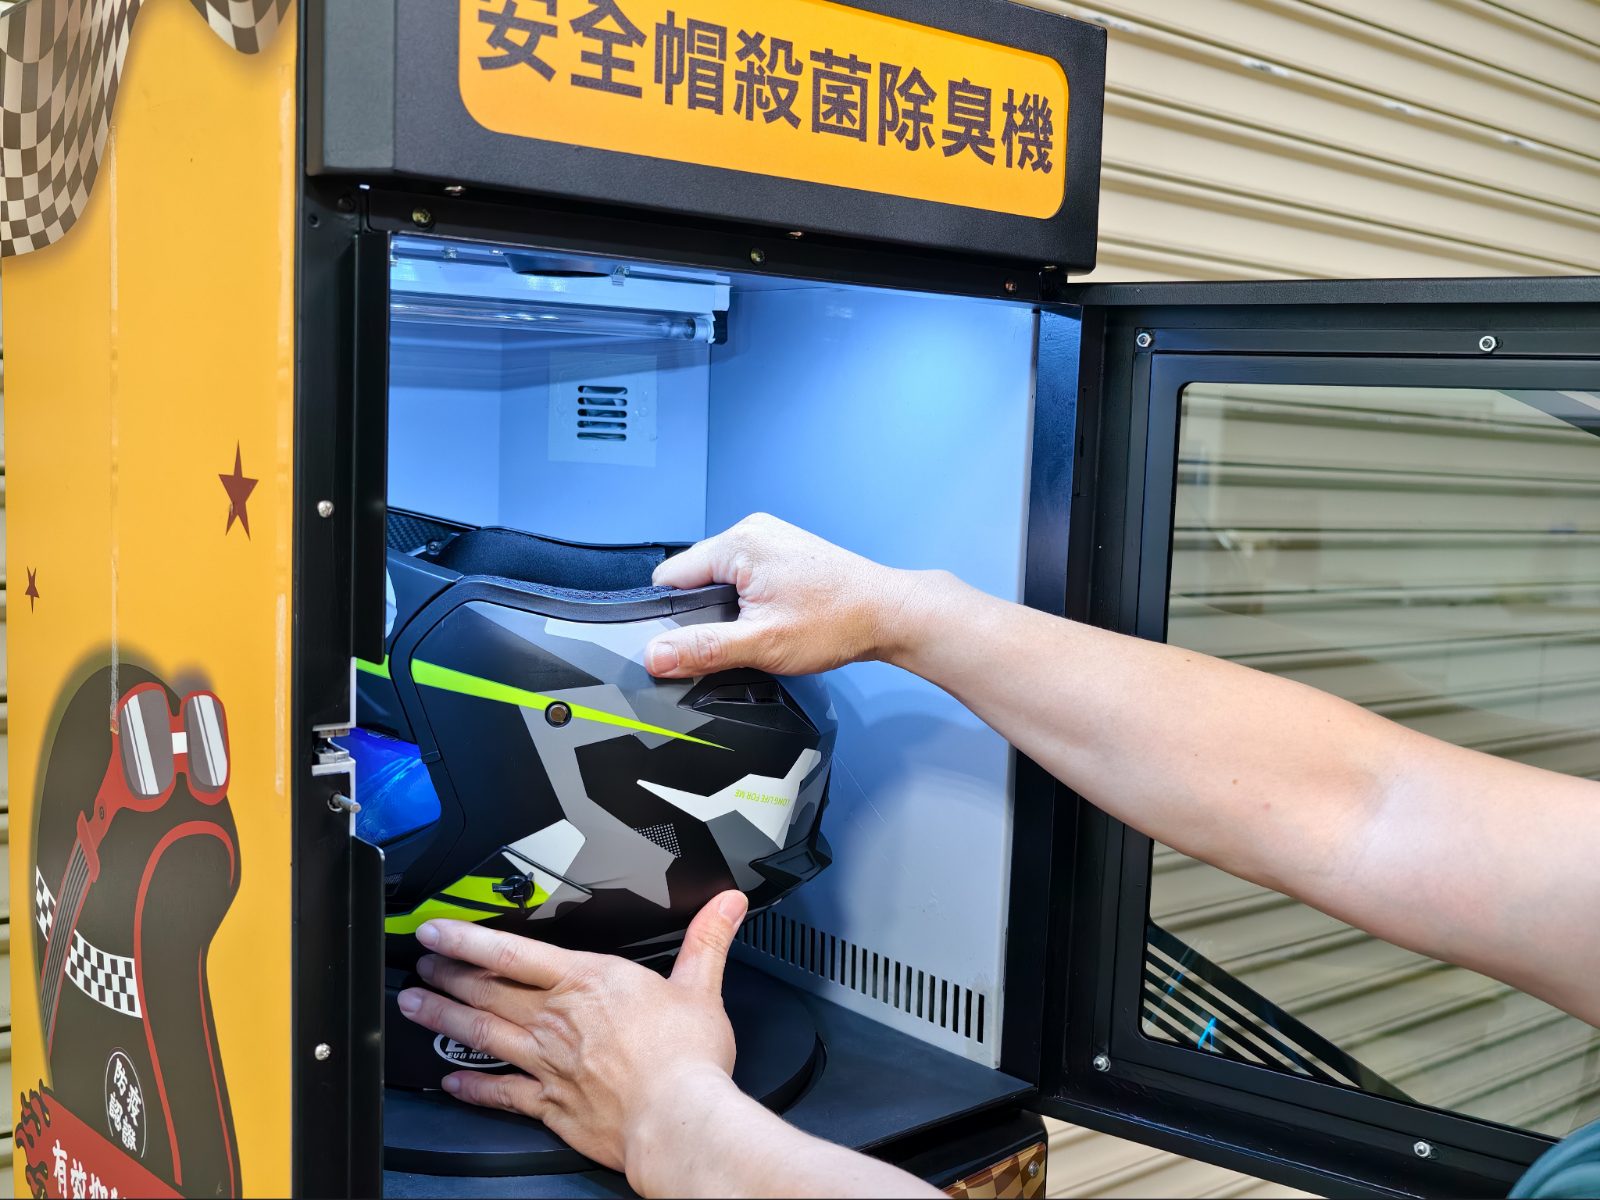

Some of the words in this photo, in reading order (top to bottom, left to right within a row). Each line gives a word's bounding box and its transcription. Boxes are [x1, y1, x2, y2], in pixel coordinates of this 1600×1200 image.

[478, 0, 1053, 174] 安全帽殺菌除臭機
